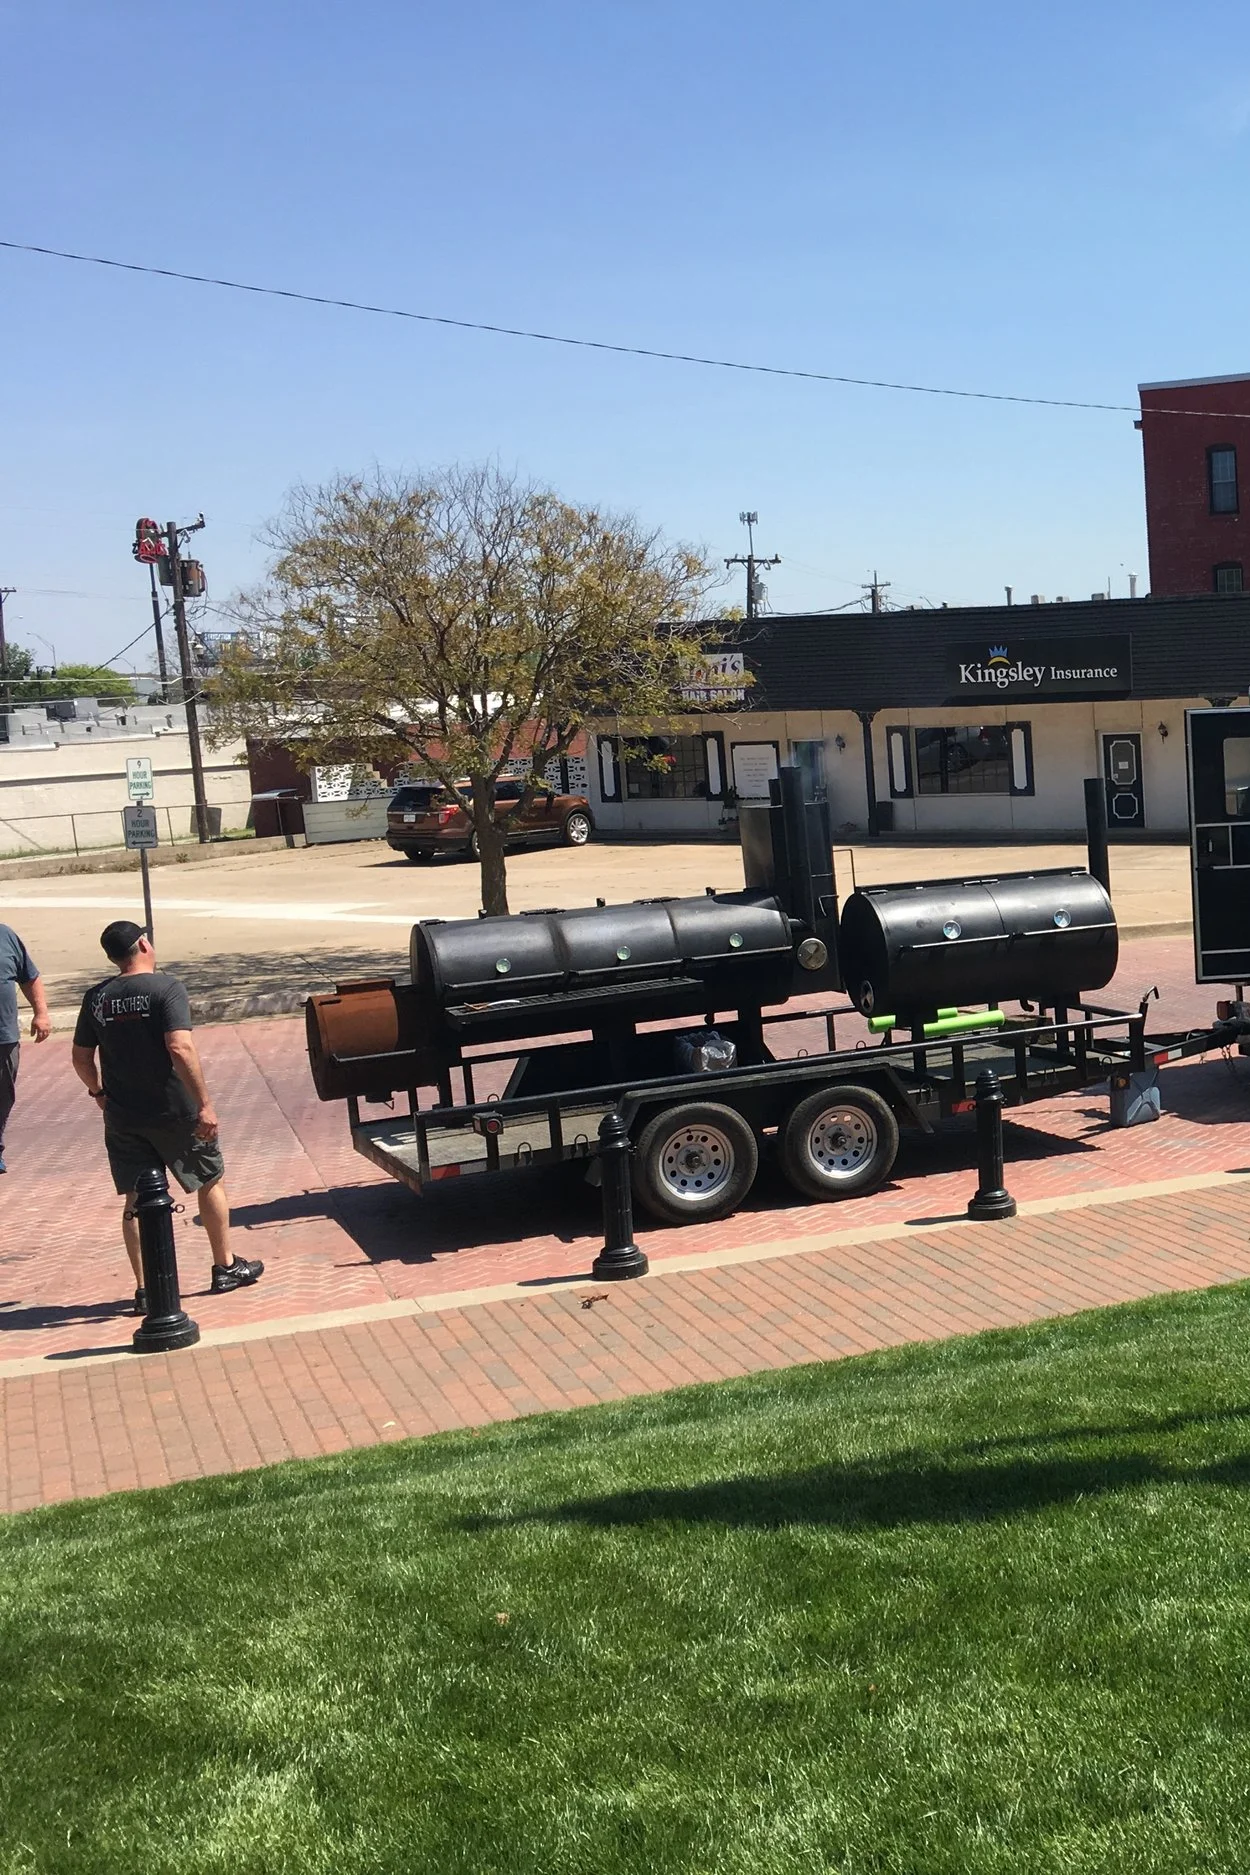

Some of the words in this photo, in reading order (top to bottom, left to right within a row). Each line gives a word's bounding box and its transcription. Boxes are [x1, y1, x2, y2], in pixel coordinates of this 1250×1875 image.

[959, 661, 1046, 689] Kingsley
[1050, 666, 1118, 680] Insurance
[681, 689, 708, 702] HAIR
[131, 771, 147, 779] HOUR
[129, 781, 152, 790] PARKING
[136, 809, 142, 818] 2
[131, 819, 149, 828] HOUR
[127, 829, 155, 839] PARKING
[111, 995, 150, 1014] FEATHERS
